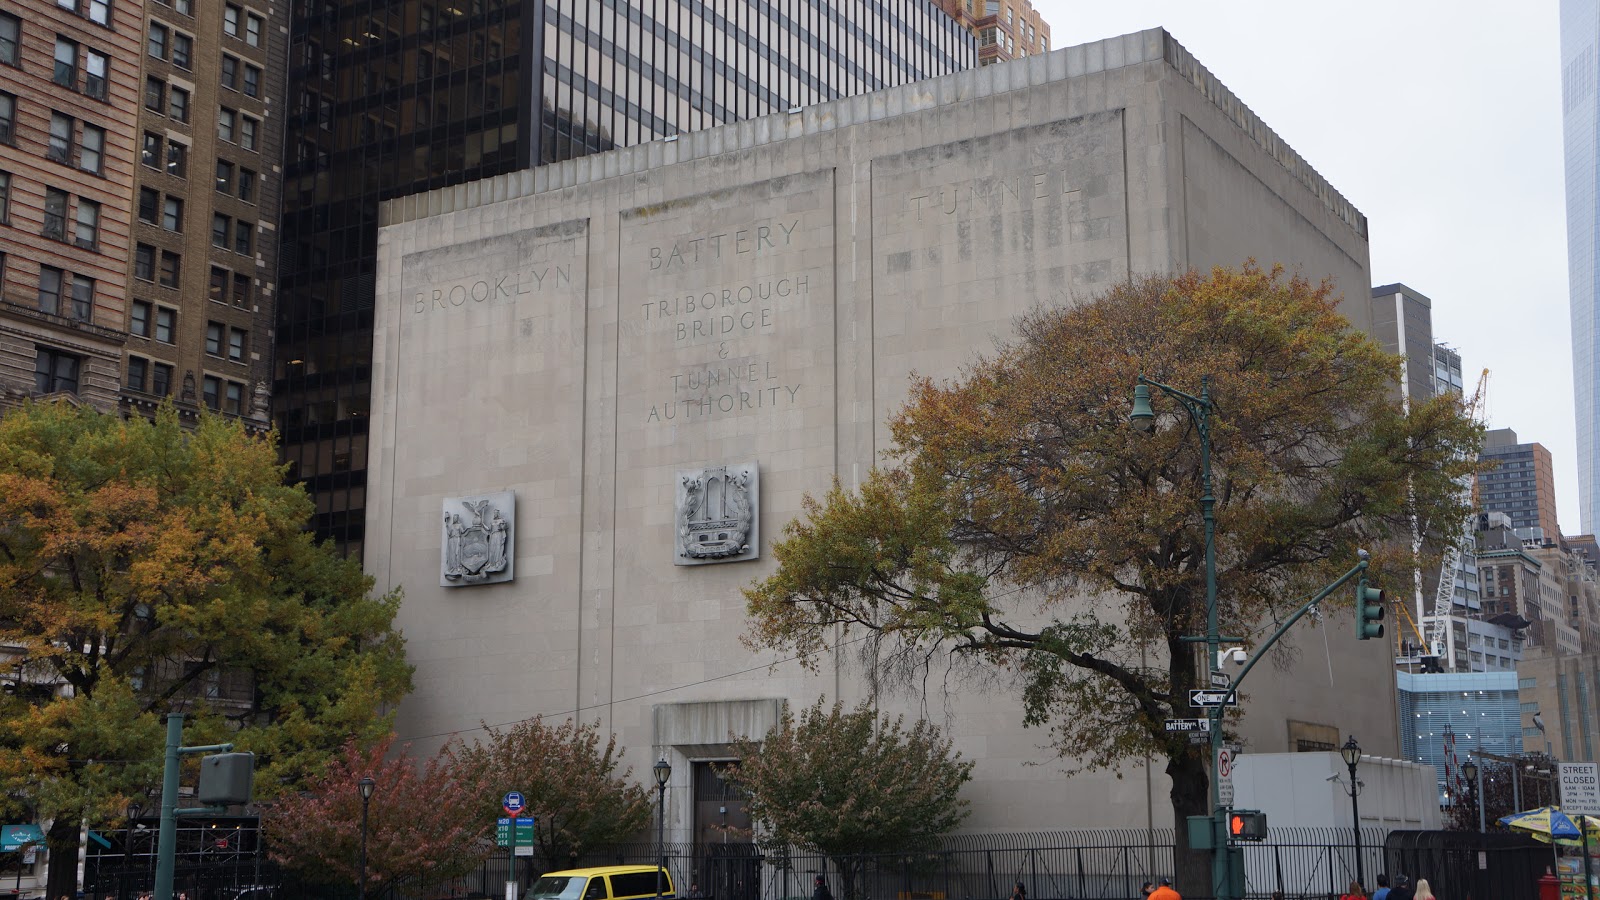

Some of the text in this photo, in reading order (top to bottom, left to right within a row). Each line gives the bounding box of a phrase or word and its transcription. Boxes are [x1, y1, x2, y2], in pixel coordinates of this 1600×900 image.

[910, 169, 1082, 222] TUNNEL
[649, 219, 799, 271] BATTERY
[414, 263, 571, 314] BROOKLYN
[641, 275, 809, 320] TRIBOROUGH
[676, 308, 772, 341] BRIDGE
[718, 341, 730, 360] &
[670, 361, 778, 394] TUNNEL
[647, 383, 801, 423] AUTHORITY
[1165, 722, 1192, 731] BATTERY
[1562, 766, 1594, 774] STREET
[1562, 776, 1596, 784] CLOSED
